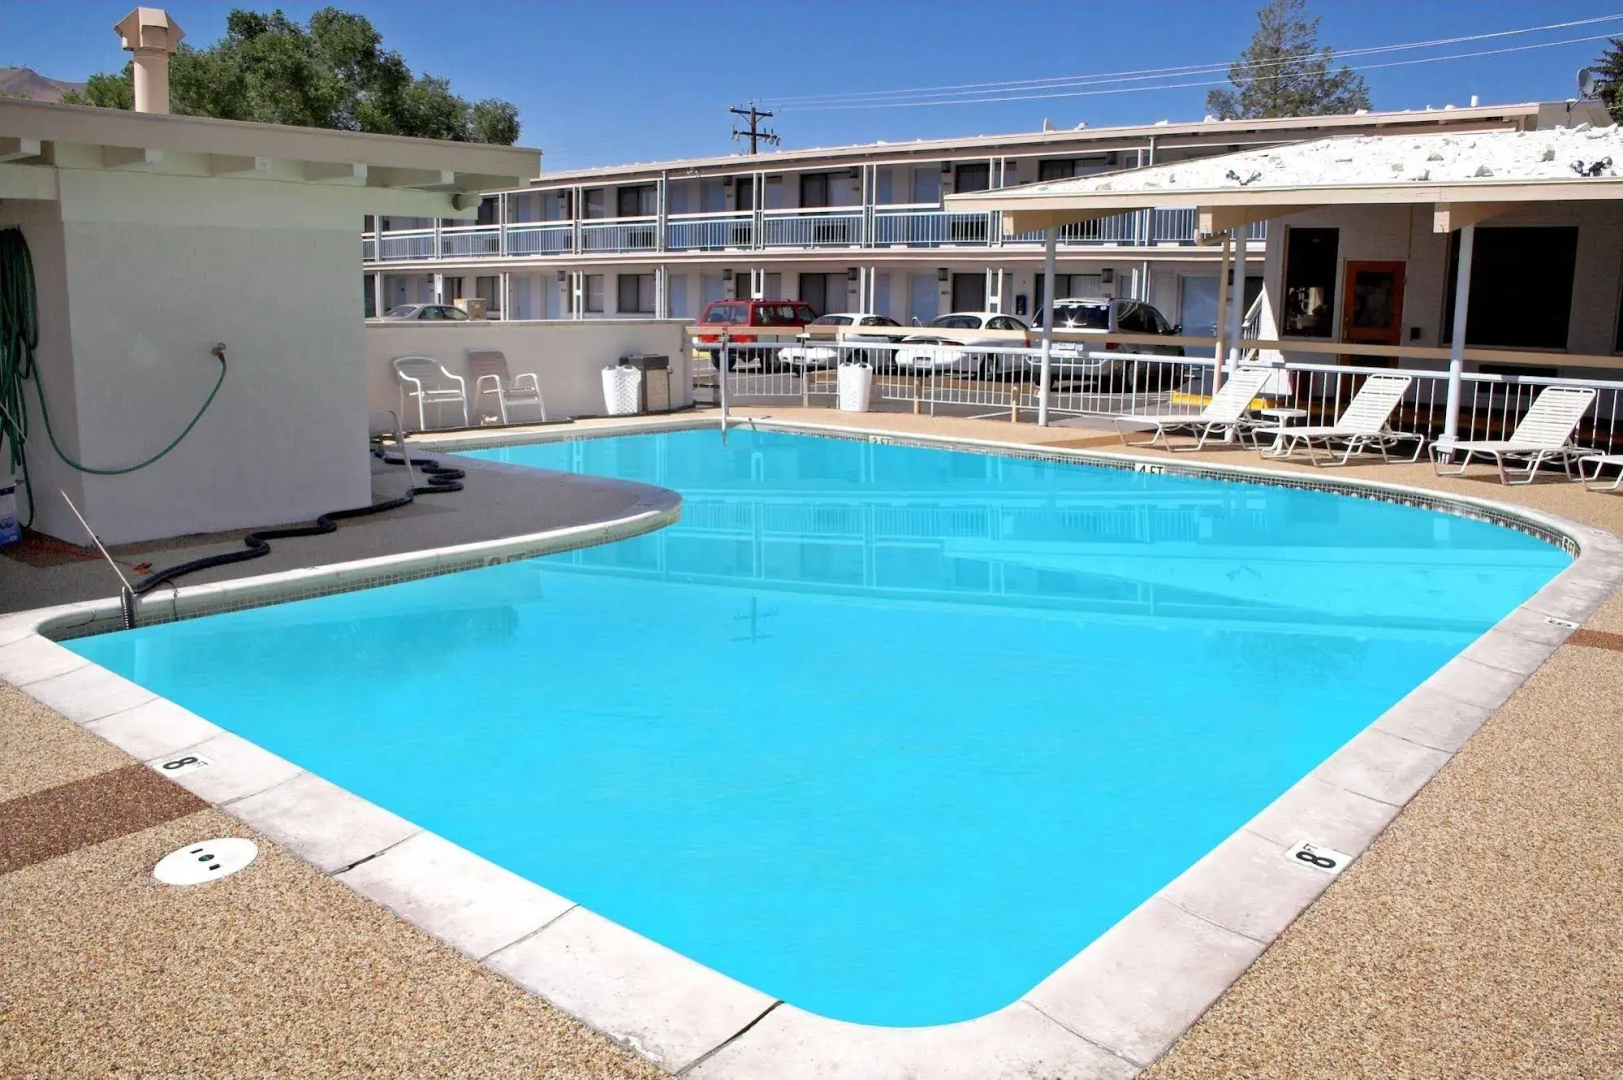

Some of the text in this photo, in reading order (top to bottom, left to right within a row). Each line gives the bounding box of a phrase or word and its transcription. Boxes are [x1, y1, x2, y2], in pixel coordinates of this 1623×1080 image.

[163, 756, 198, 770] 8
[1295, 842, 1336, 869] 8 FT
